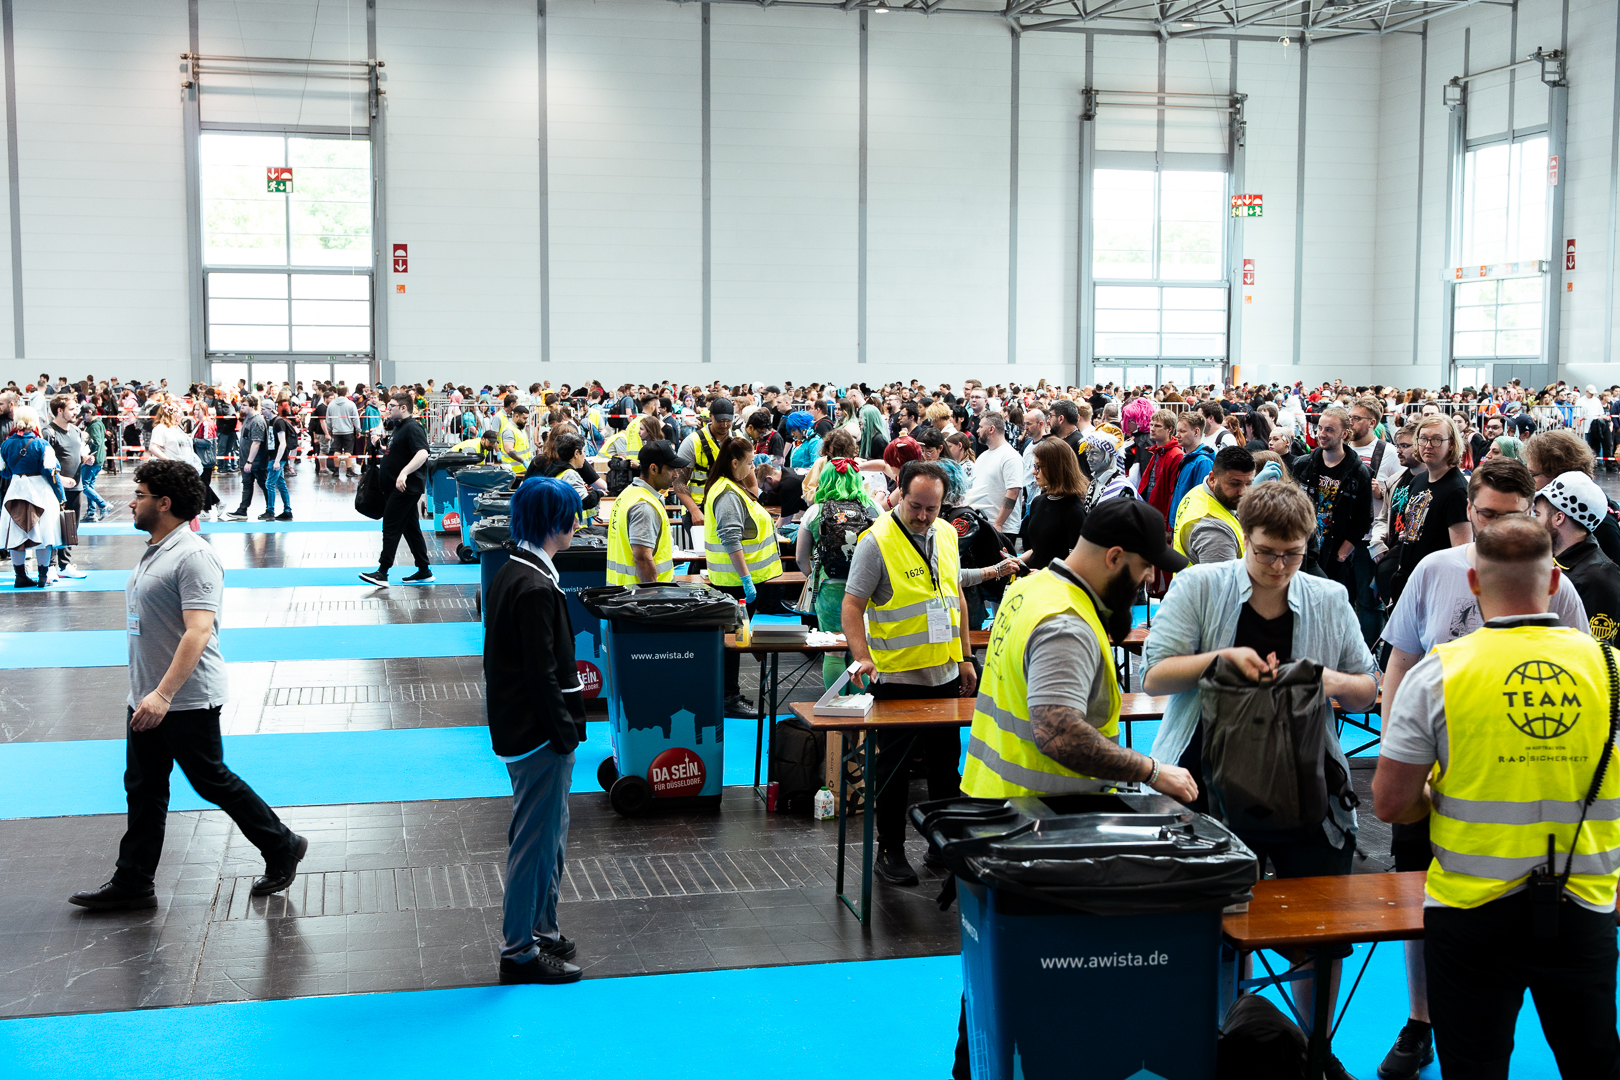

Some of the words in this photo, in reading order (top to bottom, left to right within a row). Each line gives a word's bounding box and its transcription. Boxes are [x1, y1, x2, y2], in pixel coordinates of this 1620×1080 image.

[905, 567, 925, 579] 1626
[630, 651, 695, 660] www.awista.de
[1502, 691, 1582, 707] TEAM
[652, 766, 670, 782] DA
[671, 756, 701, 780] SEIN.
[654, 782, 666, 791] FÜR
[666, 777, 702, 790] DÜSSELDORF.
[1040, 950, 1169, 969] www.awista.de
